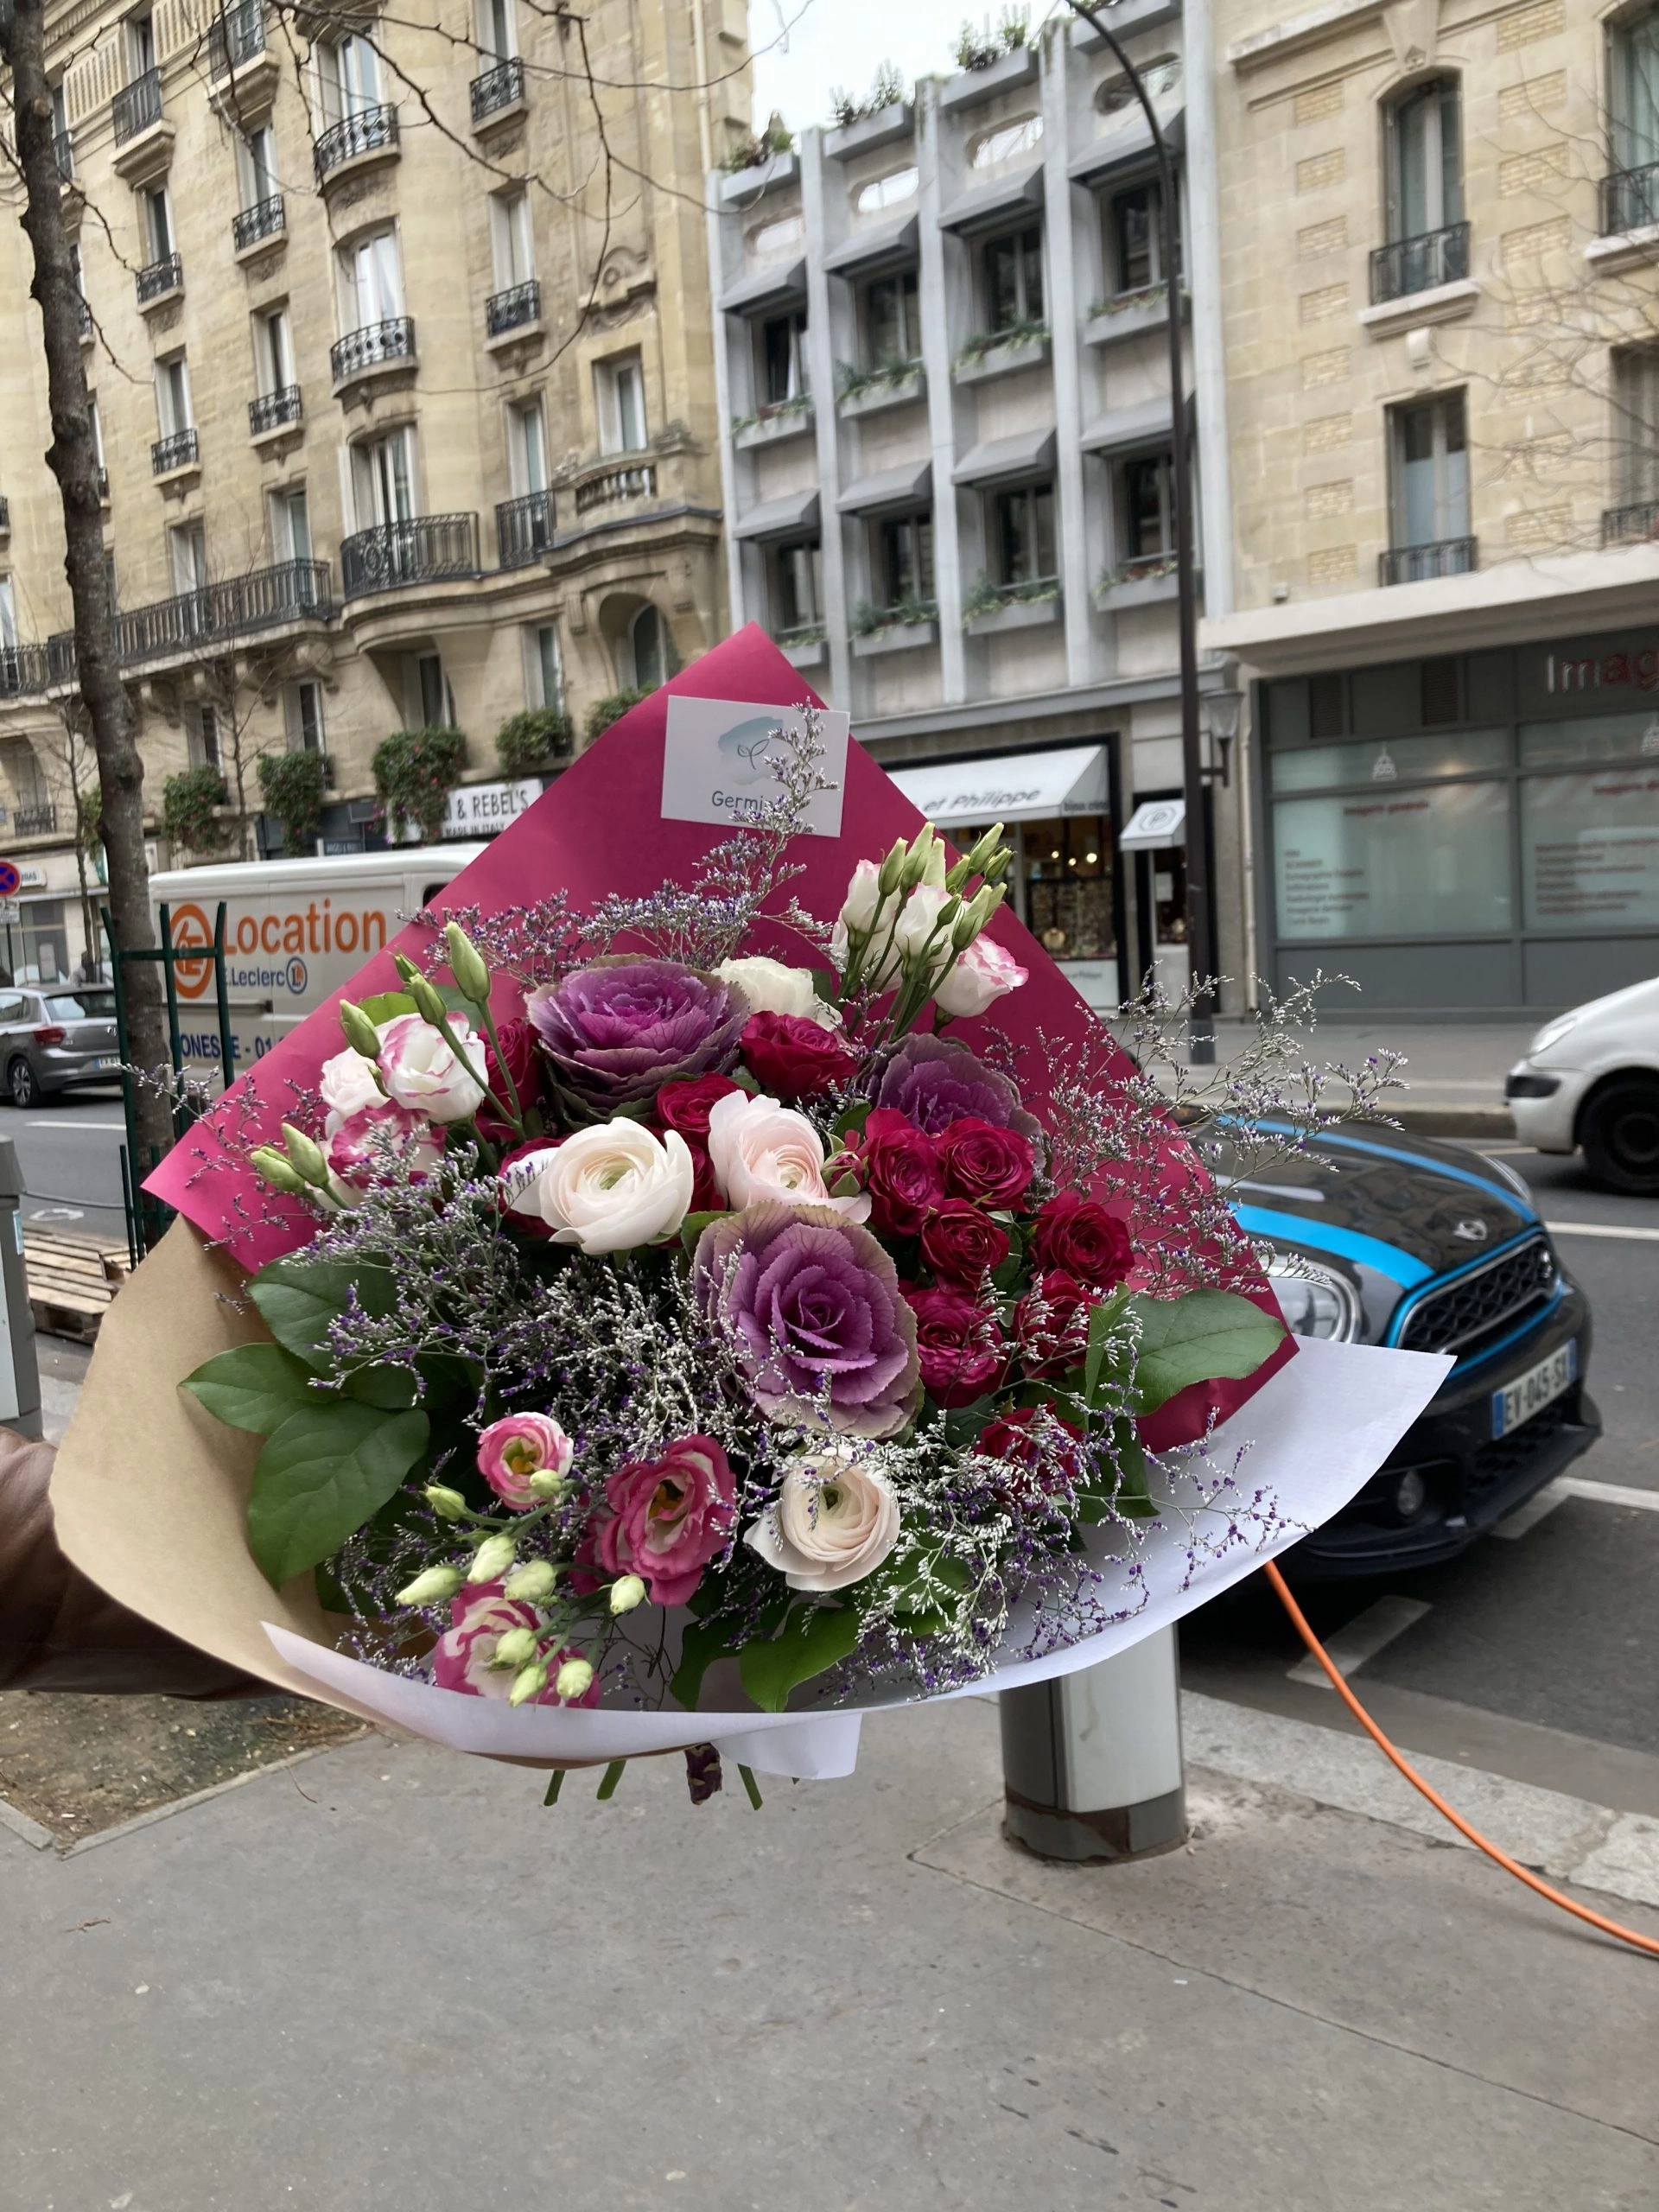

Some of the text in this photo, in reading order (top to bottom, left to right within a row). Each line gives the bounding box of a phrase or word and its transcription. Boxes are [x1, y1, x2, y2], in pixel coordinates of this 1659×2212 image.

[456, 798, 467, 820] &
[472, 788, 530, 818] REBEL'S
[923, 789, 1042, 812] et Philippe
[223, 897, 387, 955] Location
